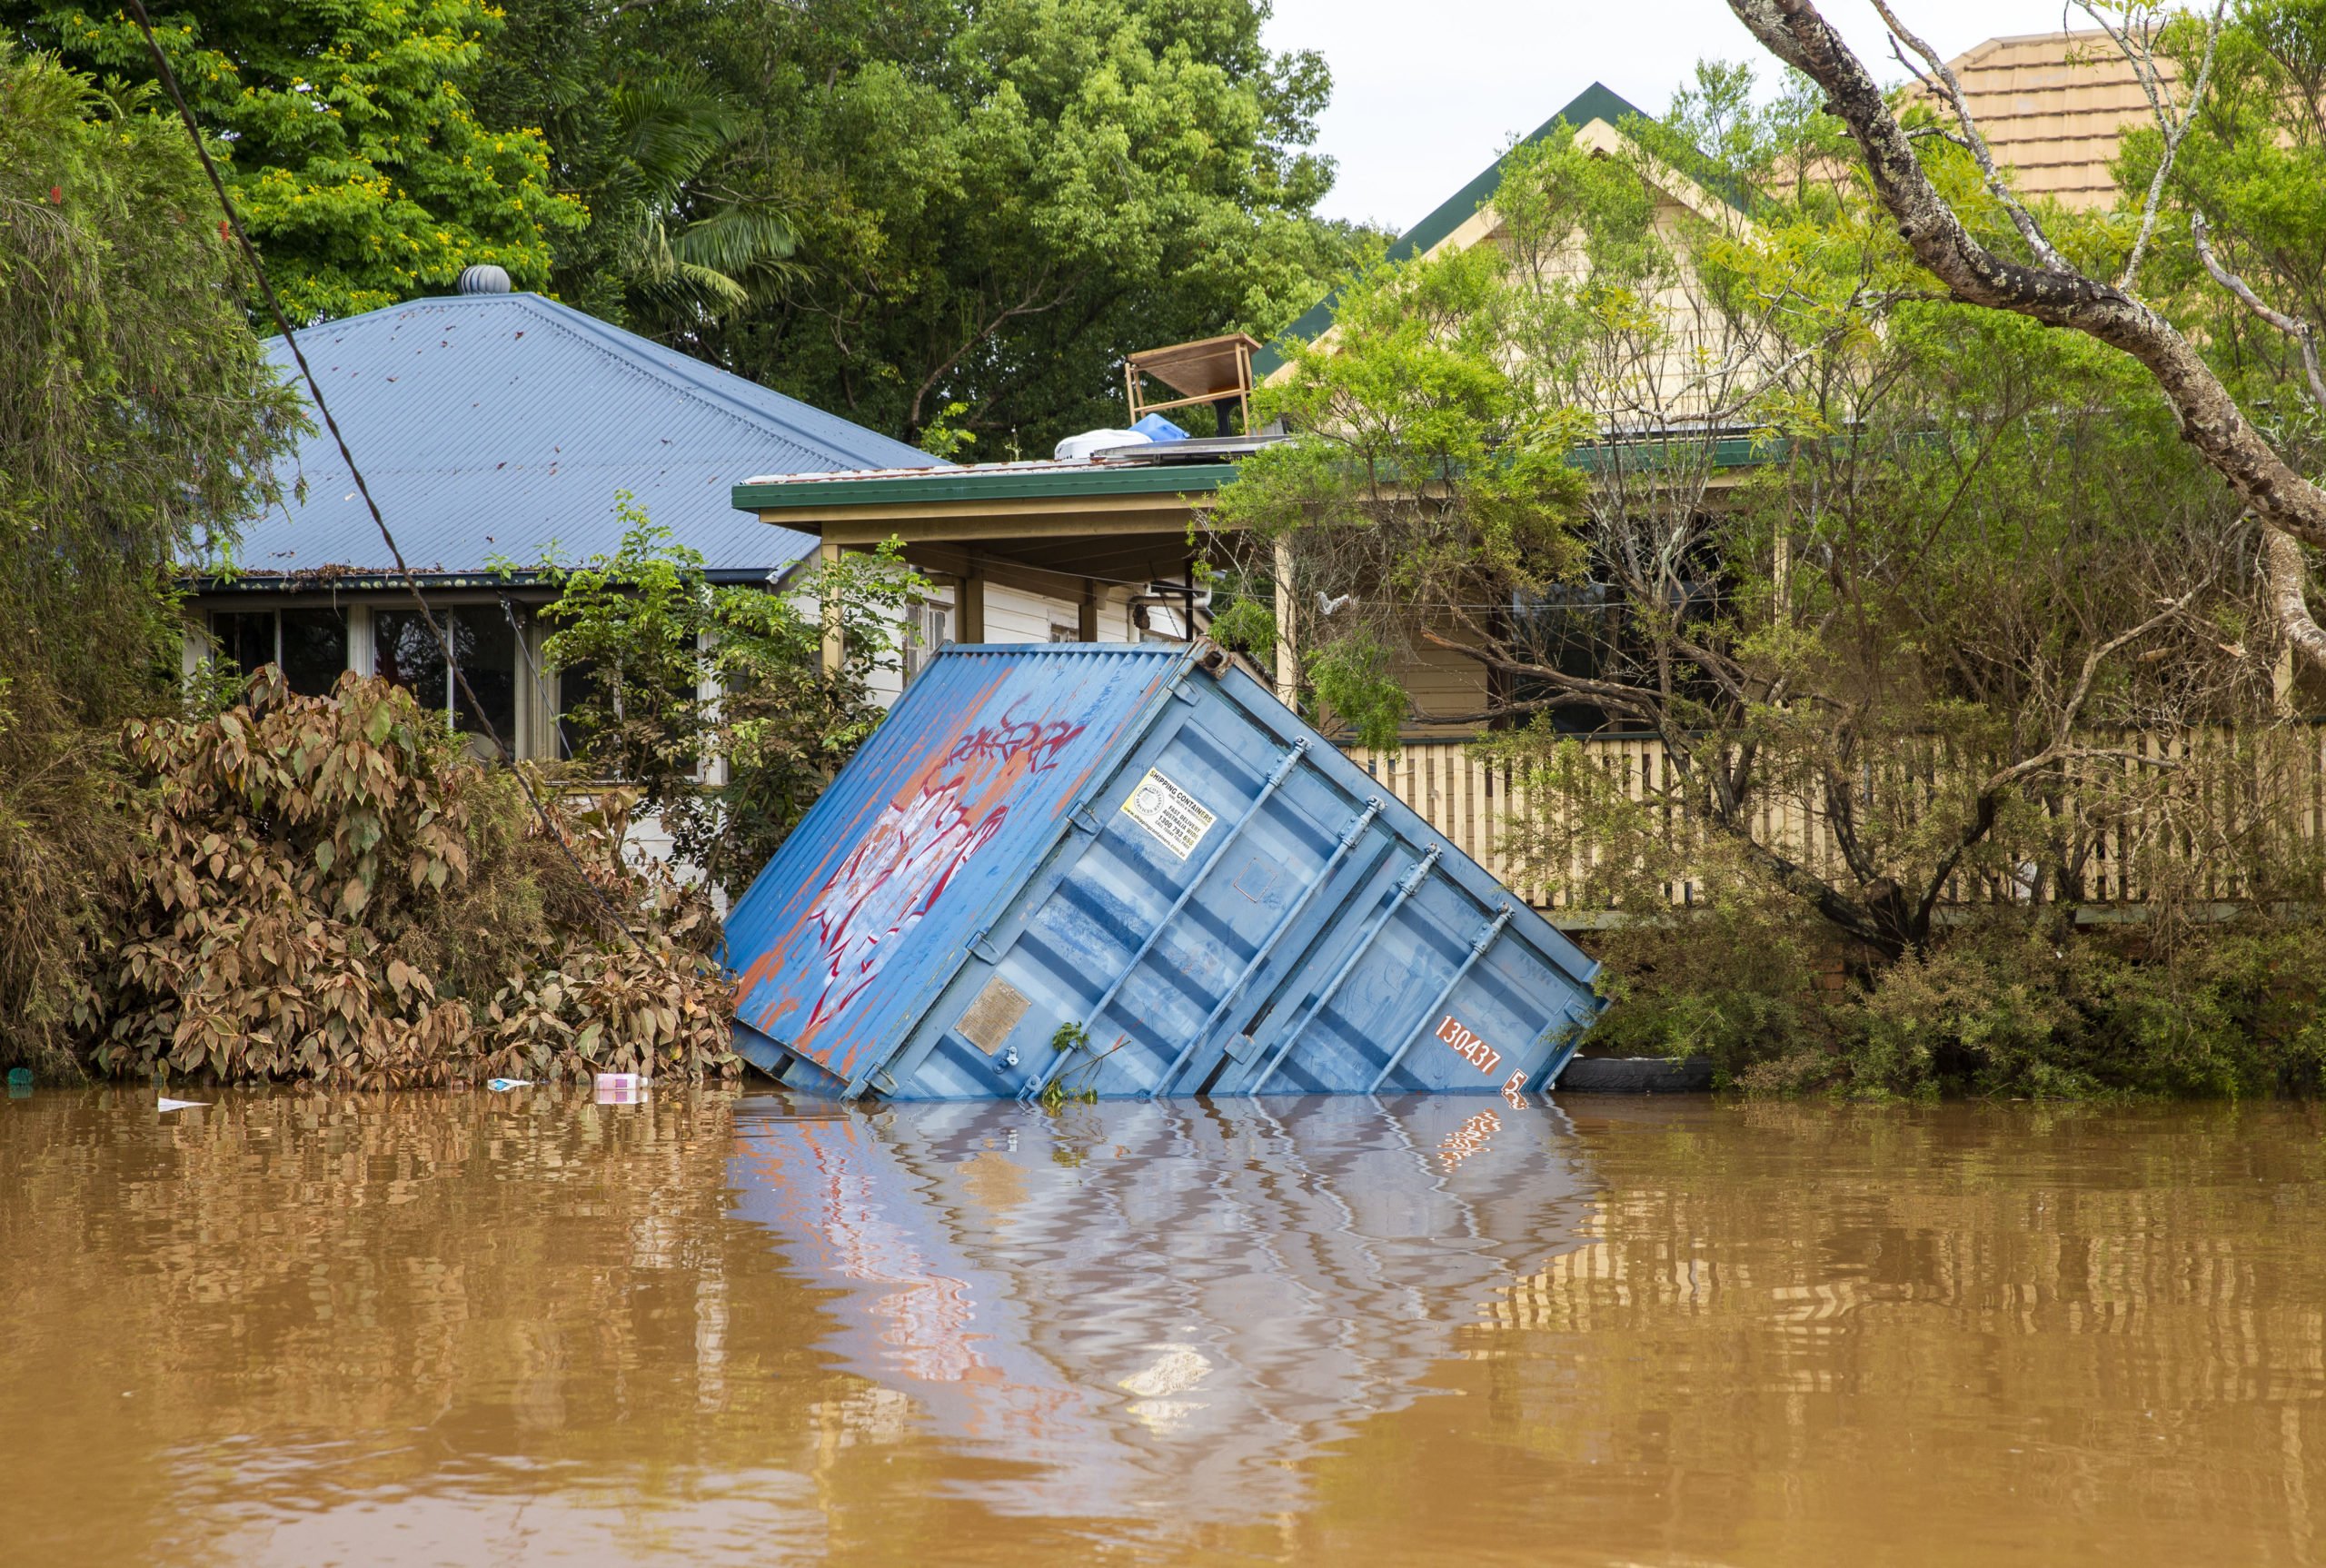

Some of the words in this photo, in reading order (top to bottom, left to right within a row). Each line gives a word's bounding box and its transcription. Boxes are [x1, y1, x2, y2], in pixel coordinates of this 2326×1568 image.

[1149, 770, 1178, 795] SHIPPING
[1176, 791, 1213, 823] CONTAINERS
[1122, 806, 1186, 858] www.shippingcontainers.com.au
[1158, 815, 1172, 829] 1300
[1172, 826, 1184, 838] 793
[1162, 809, 1187, 830] AUSTRALIA
[1186, 828, 1199, 839] WIDE
[1168, 805, 1179, 816] FAST
[1179, 814, 1201, 833] DELIVERY
[1155, 820, 1163, 829] CALL
[1163, 827, 1174, 837] TODAY
[1173, 835, 1182, 843] TOLL
[1180, 841, 1190, 849] FREE
[1436, 1015, 1501, 1073] 130437
[1505, 1071, 1525, 1092] 5
